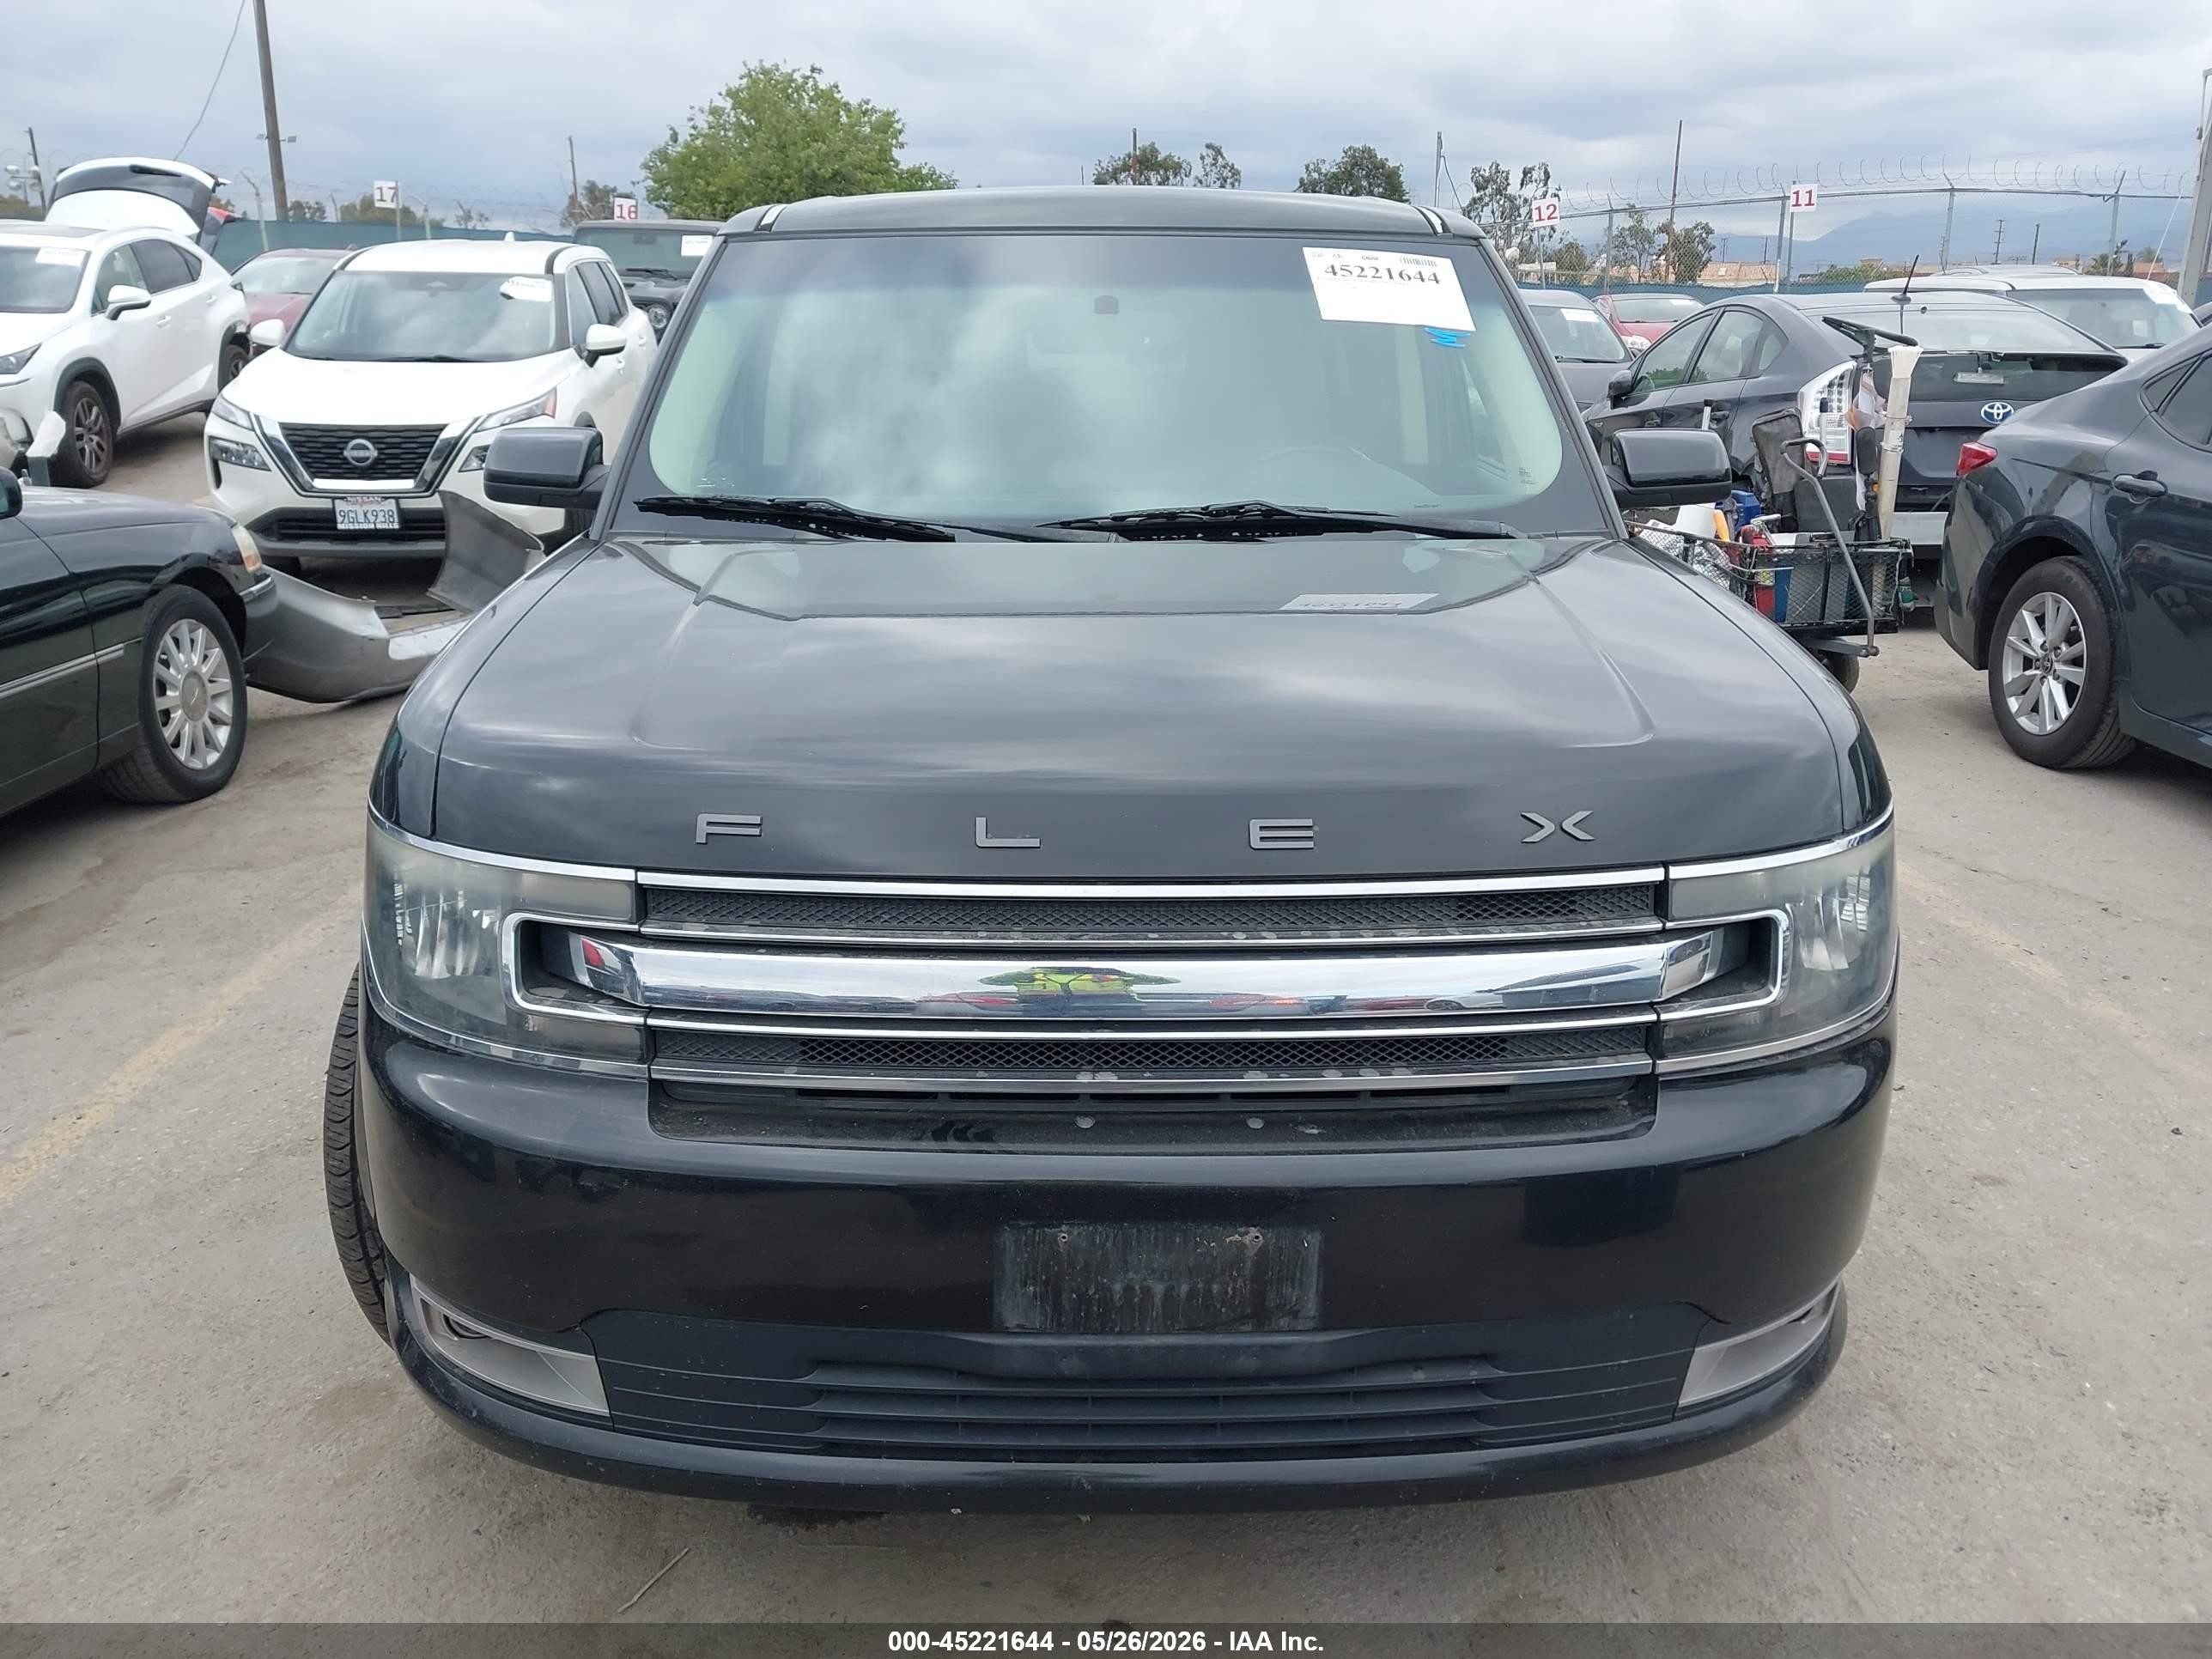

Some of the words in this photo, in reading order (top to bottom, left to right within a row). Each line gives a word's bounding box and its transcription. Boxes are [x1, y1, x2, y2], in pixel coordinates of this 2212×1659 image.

[376, 185, 398, 203] 17
[1791, 189, 1815, 207] 11
[616, 204, 638, 220] 16
[1534, 203, 1558, 222] 12
[1325, 264, 1442, 285] 45221644
[338, 508, 395, 524] 9GLK938
